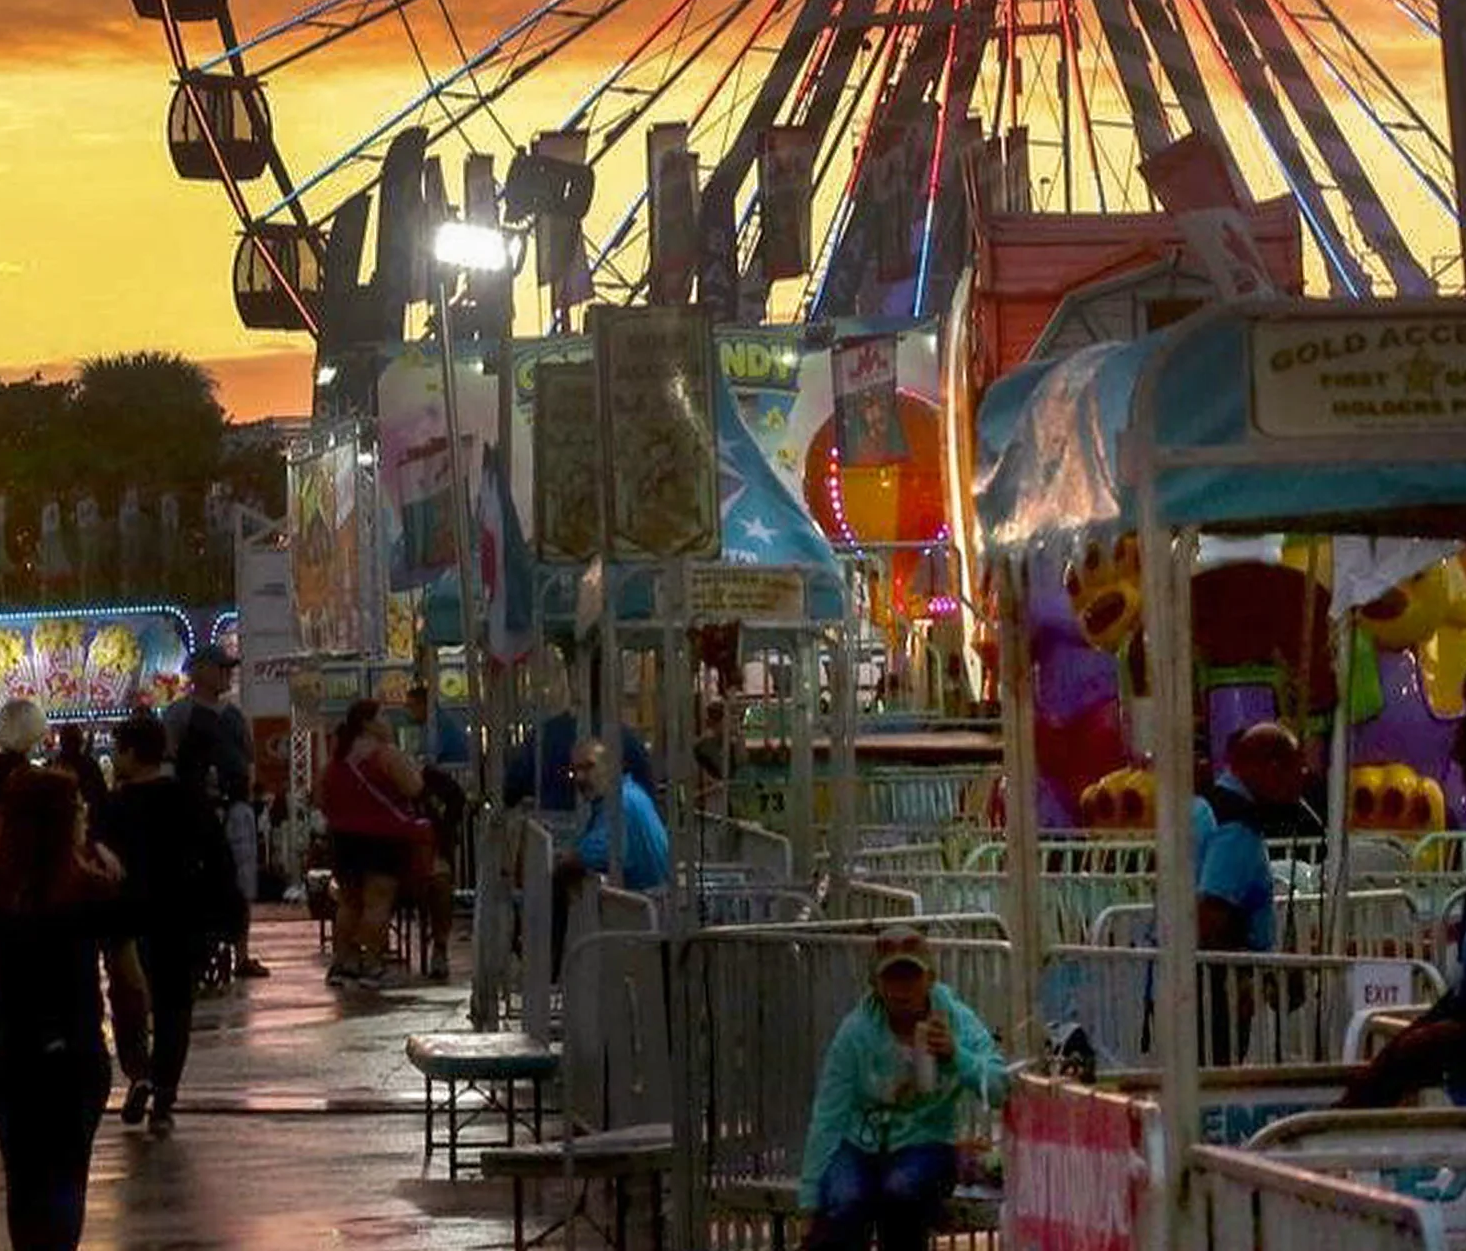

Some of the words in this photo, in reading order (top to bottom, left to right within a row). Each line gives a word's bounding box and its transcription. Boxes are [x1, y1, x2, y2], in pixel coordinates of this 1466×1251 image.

[1270, 332, 1368, 372] GOLD
[1319, 370, 1391, 387] FIRST
[1333, 400, 1446, 417] HOLDERS
[1364, 986, 1399, 1005] EXIT
